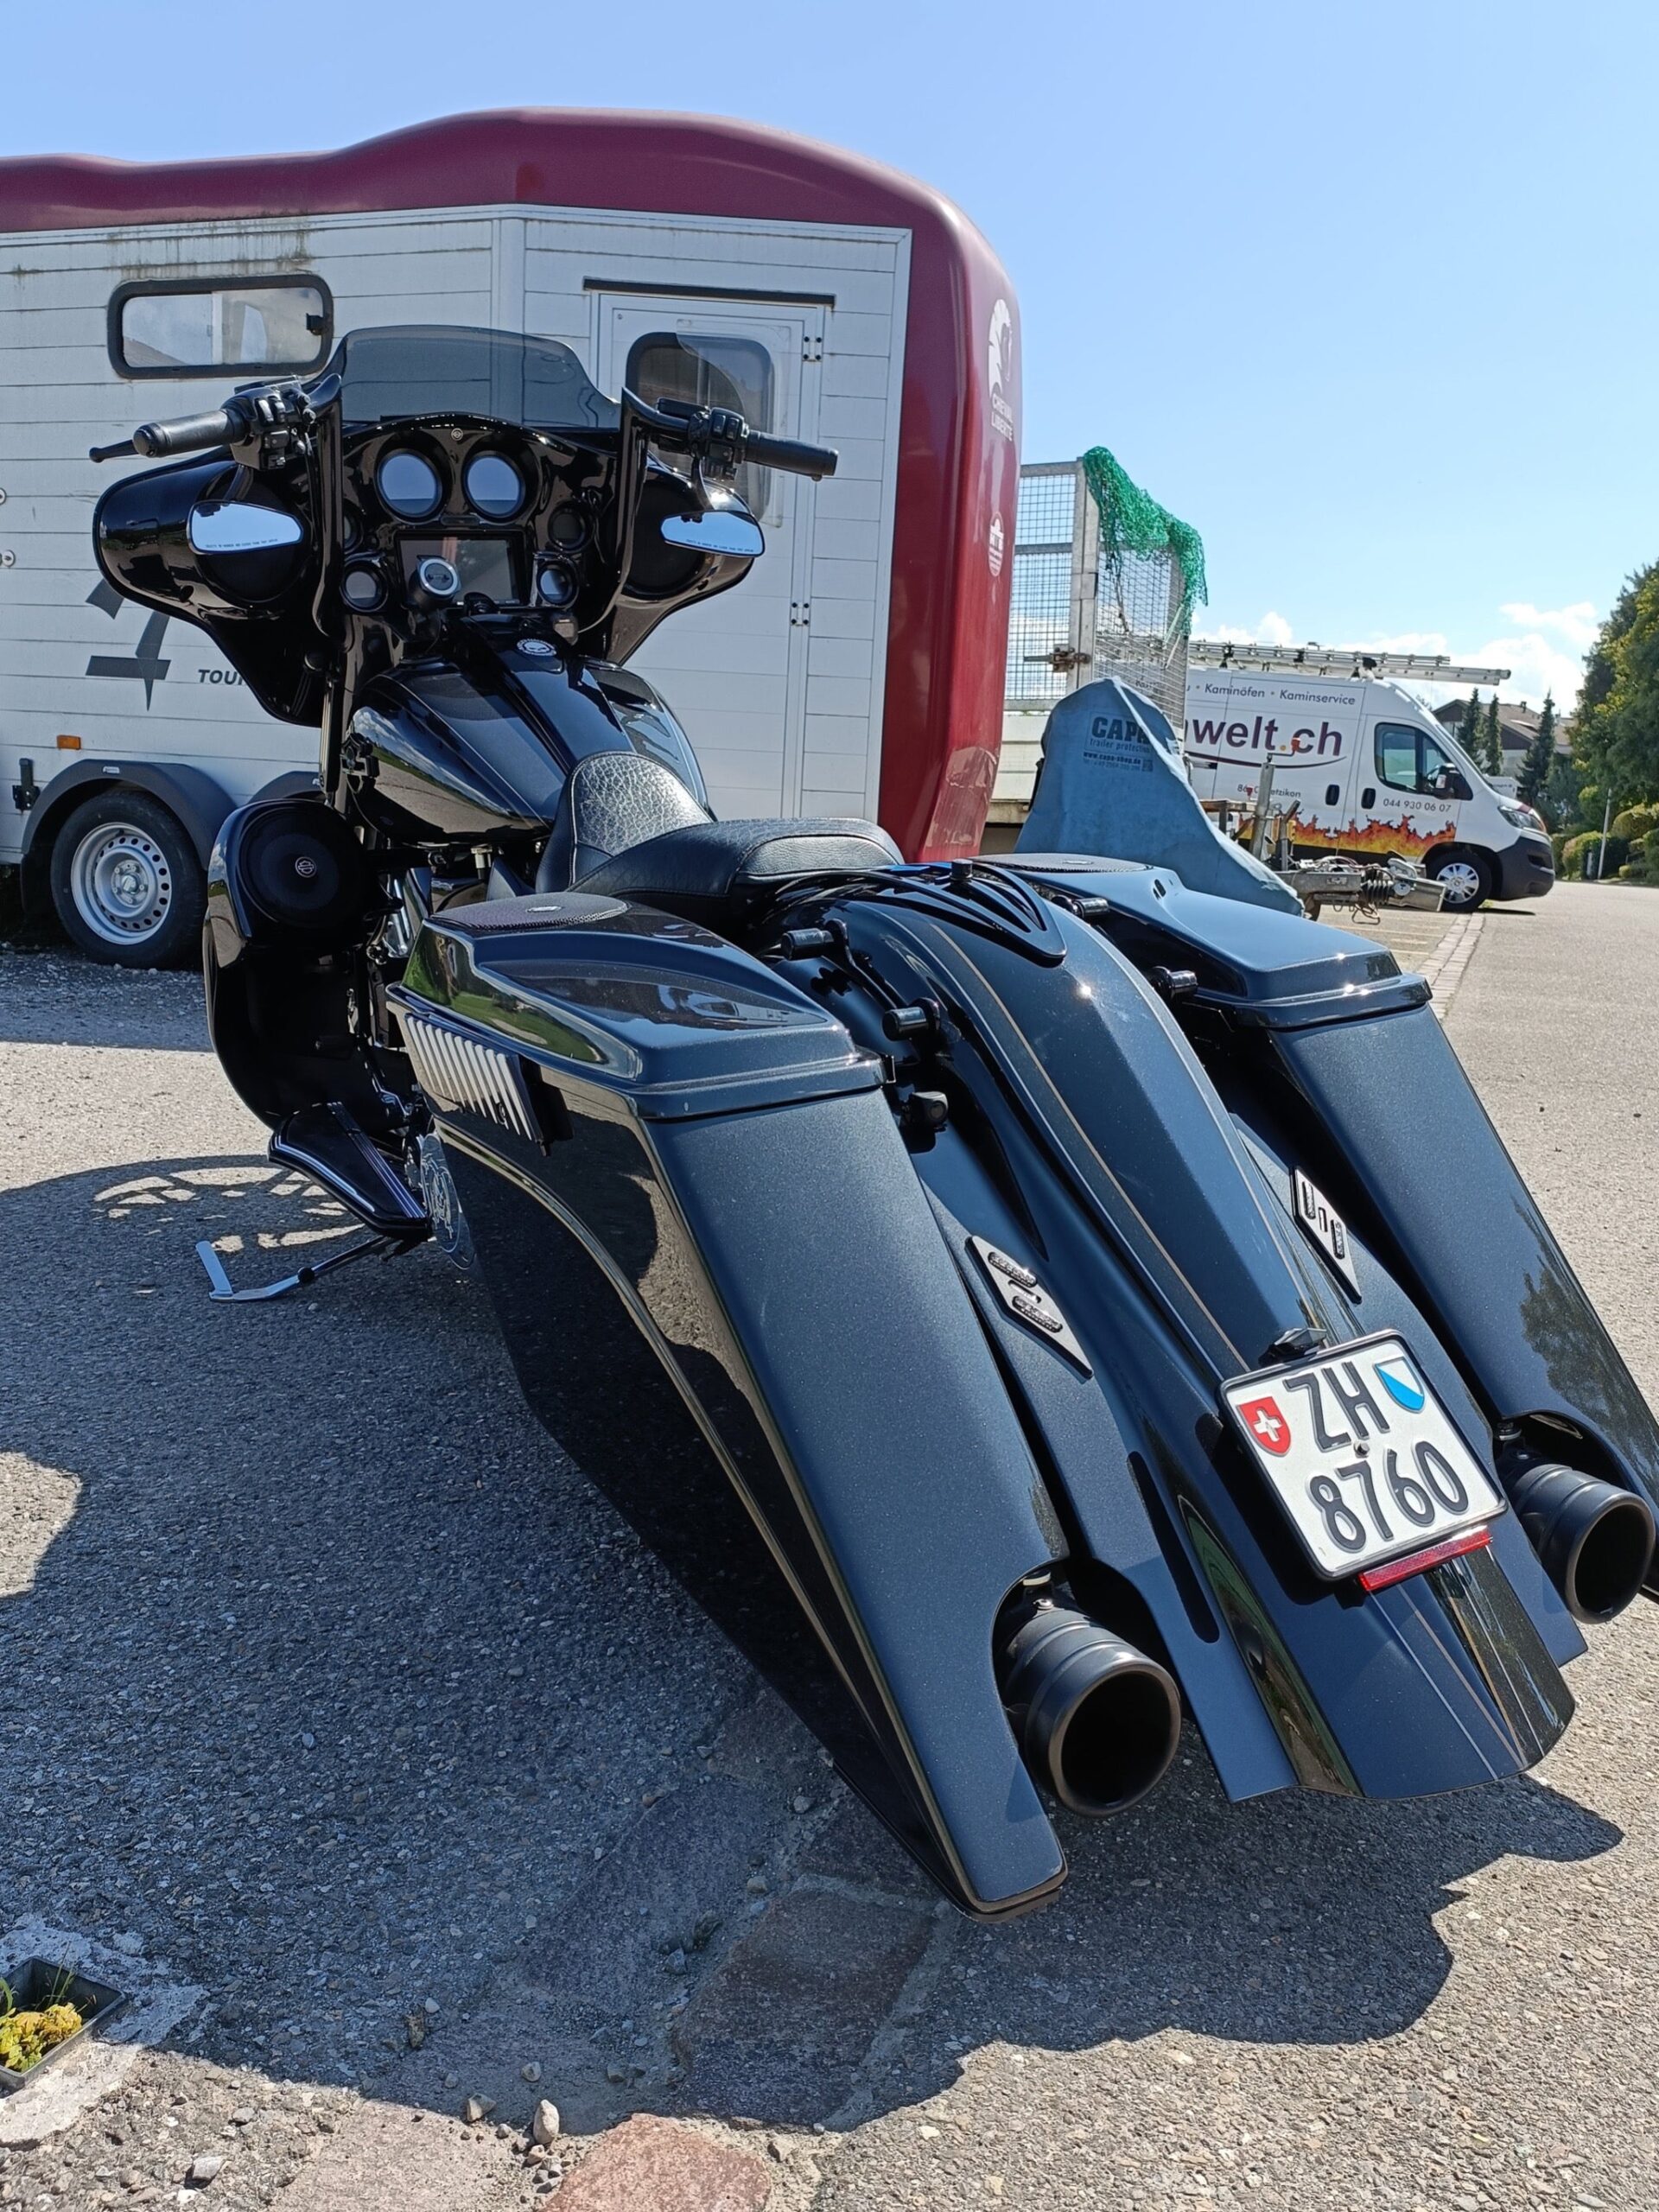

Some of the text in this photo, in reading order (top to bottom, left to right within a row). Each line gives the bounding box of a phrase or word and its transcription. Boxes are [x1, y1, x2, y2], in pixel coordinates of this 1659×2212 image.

[1205, 683, 1265, 698] Kaminöfen
[1279, 689, 1356, 705] Kaminservice
[1090, 738, 1114, 749] trailer
[1185, 715, 1343, 756] welt.ch
[1270, 787, 1302, 798] etzikon
[1382, 798, 1452, 812] 044 930 06 07
[1282, 1361, 1390, 1452] ZH
[1306, 1440, 1469, 1553] 8760
